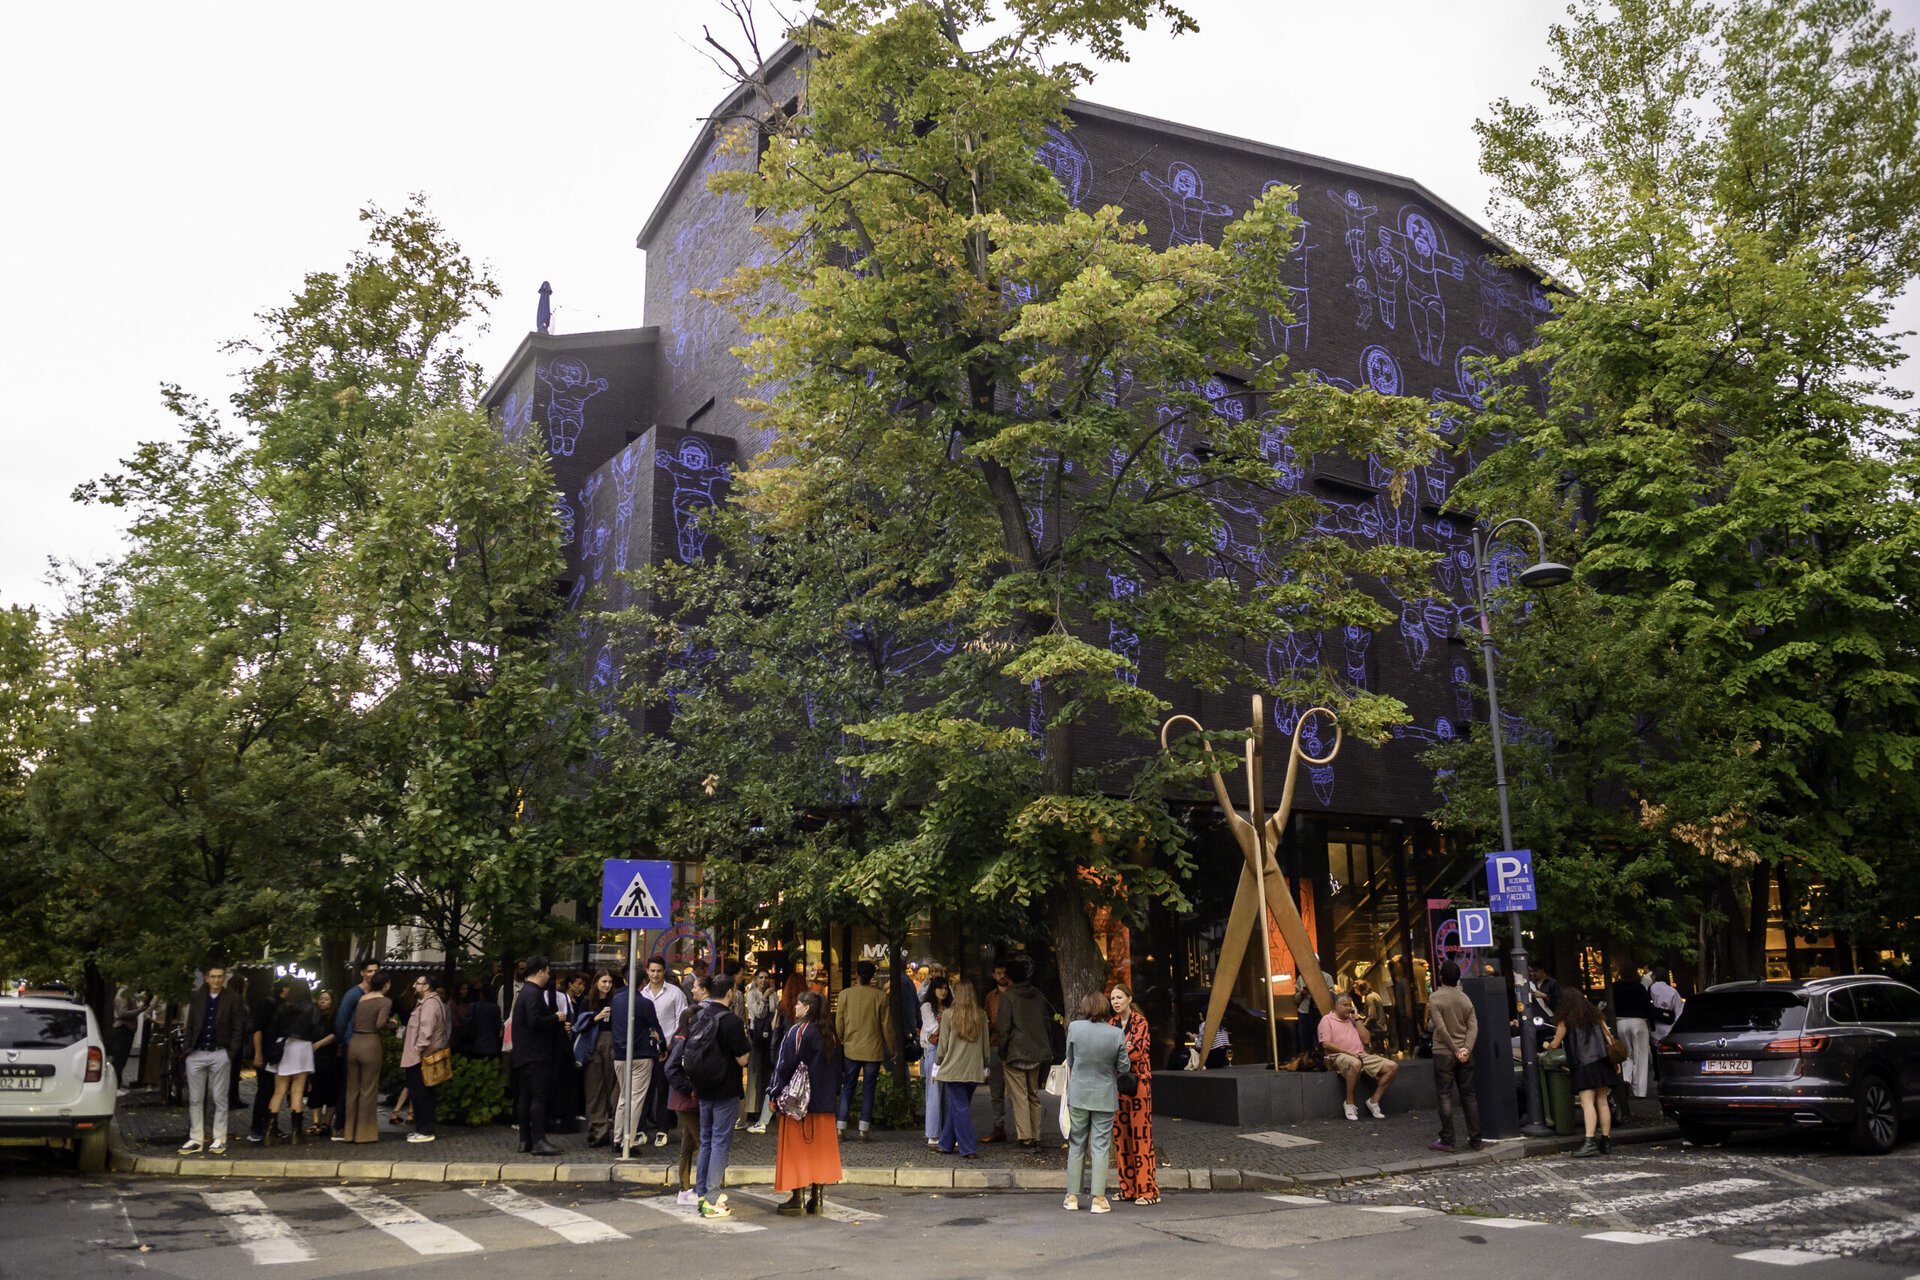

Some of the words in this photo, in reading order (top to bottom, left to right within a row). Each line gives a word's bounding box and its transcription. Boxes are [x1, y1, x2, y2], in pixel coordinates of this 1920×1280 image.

[1496, 857, 1521, 893] P
[276, 962, 321, 990] BEANS
[1707, 1061, 1716, 1070] IF
[1719, 1061, 1727, 1070] 14
[1729, 1061, 1749, 1070] RZO
[17, 1078, 38, 1088] AAT
